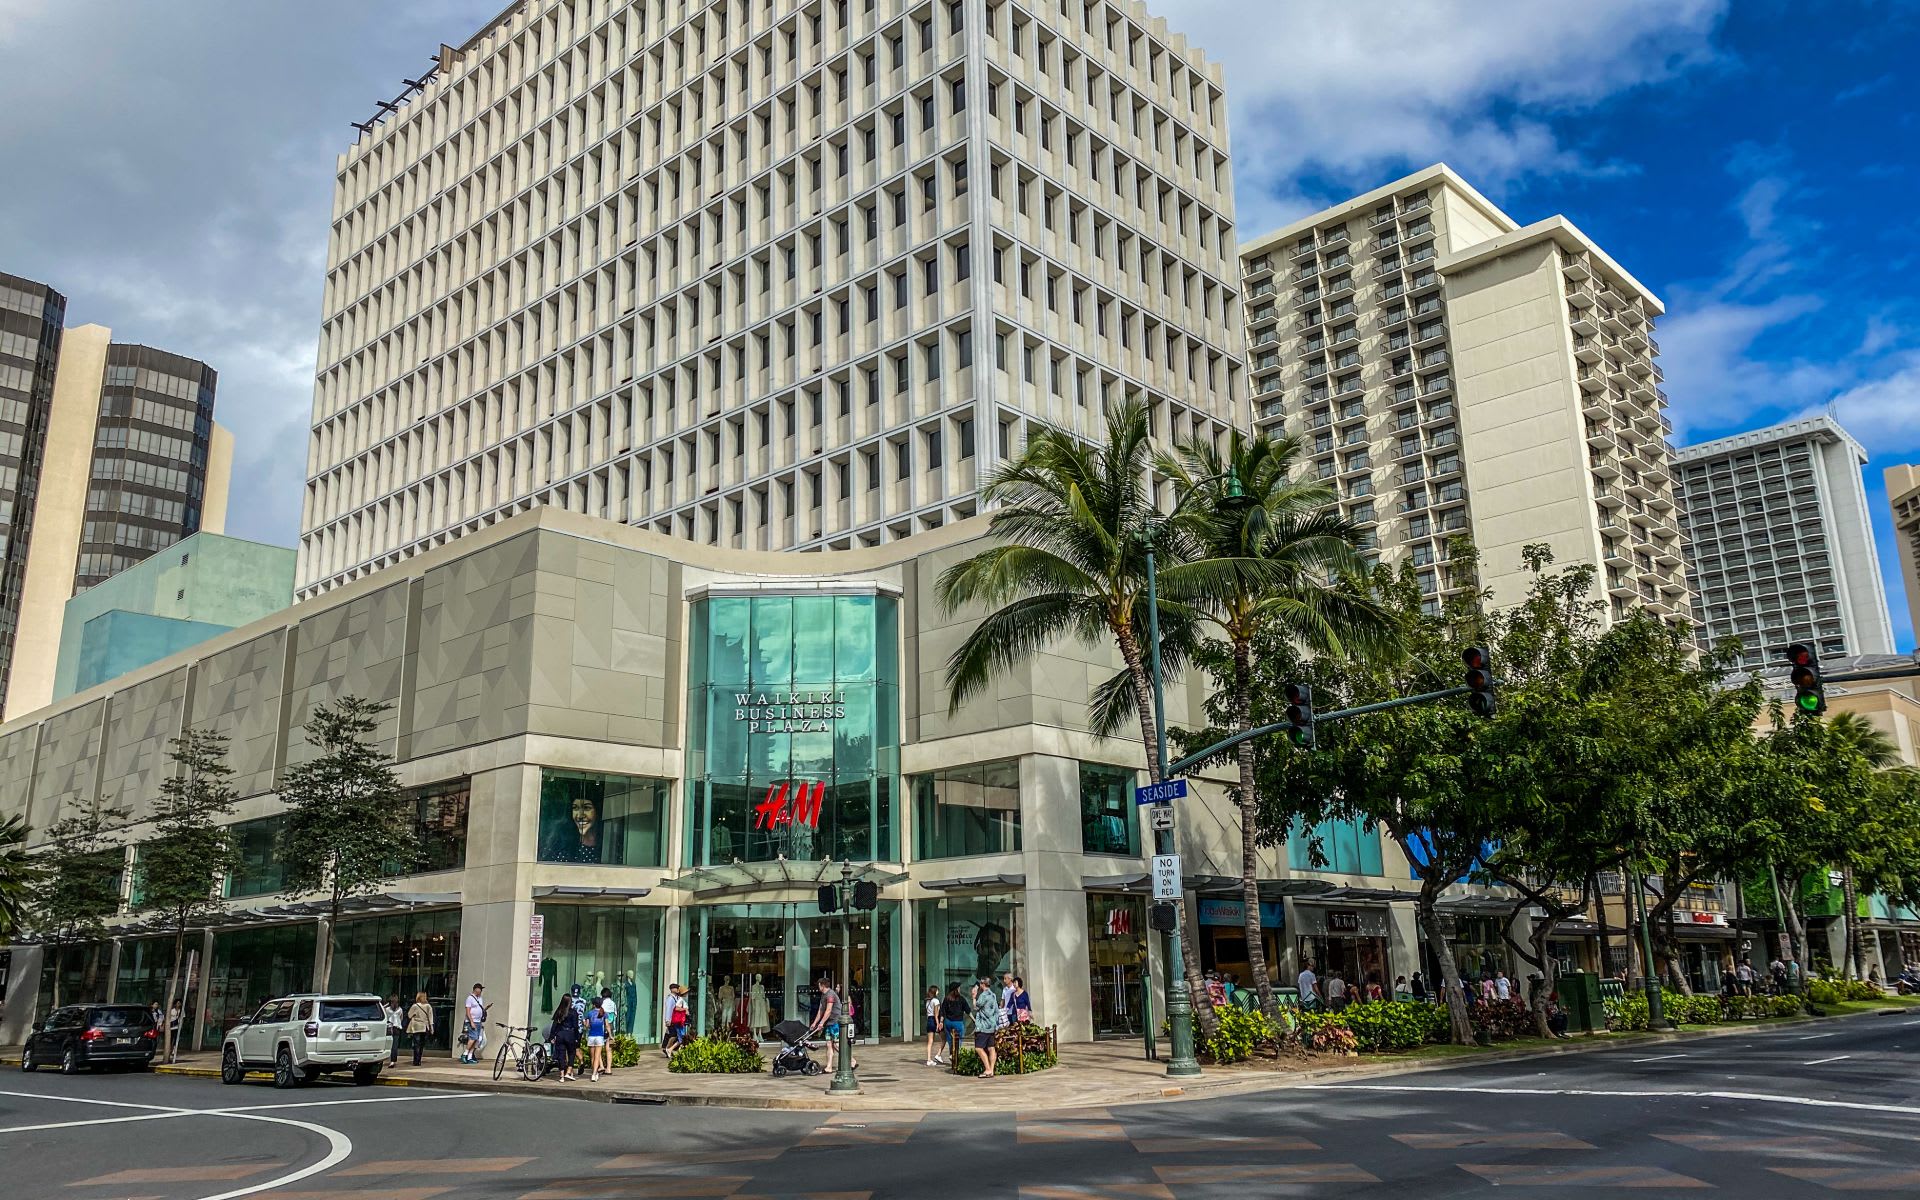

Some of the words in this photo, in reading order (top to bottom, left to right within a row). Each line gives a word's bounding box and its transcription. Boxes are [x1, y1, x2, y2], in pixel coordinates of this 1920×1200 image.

[735, 692, 845, 705] WAIKIKI
[735, 707, 845, 720] BUSINESS
[749, 720, 829, 733] PLAZA
[1142, 783, 1180, 802] SEASIDE
[755, 781, 825, 830] H&M
[1151, 810, 1162, 819] ONE
[1163, 809, 1173, 818] WAY
[1159, 858, 1173, 868] NO
[1158, 869, 1175, 877] TURN
[1162, 879, 1172, 887] ON
[1161, 888, 1174, 896] RED
